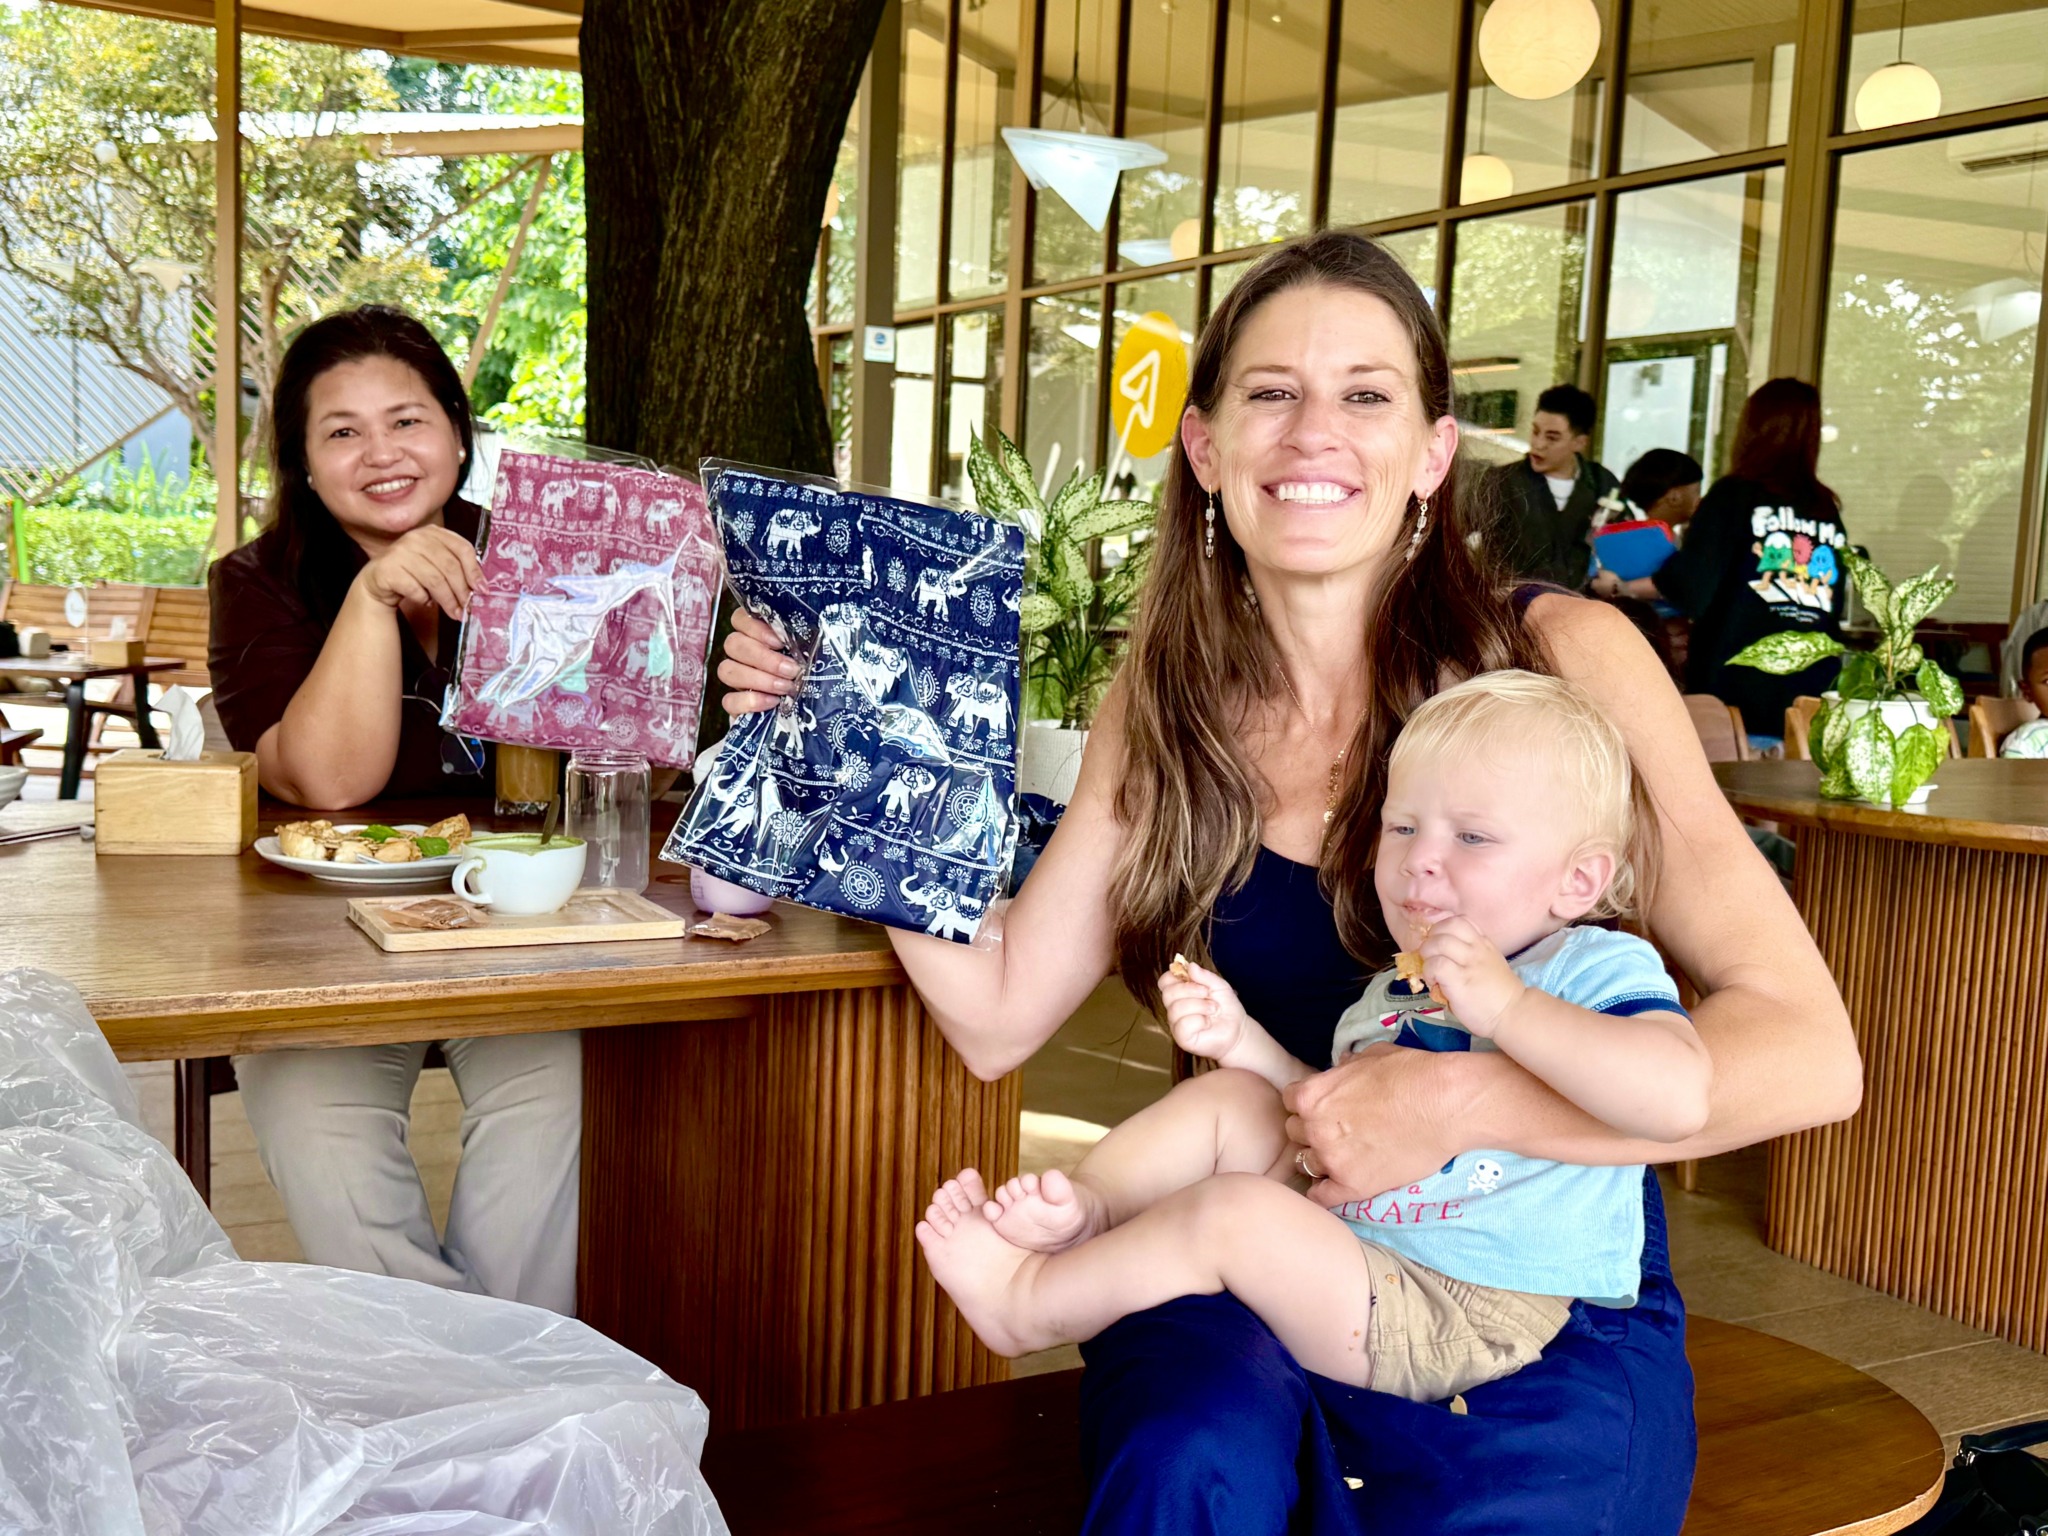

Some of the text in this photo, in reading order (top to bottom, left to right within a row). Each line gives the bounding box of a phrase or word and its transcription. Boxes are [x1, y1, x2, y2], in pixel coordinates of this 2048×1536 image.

[1751, 506, 1846, 548] Follow Me
[1408, 1184, 1423, 1195] a
[1342, 1199, 1464, 1224] IRATE
